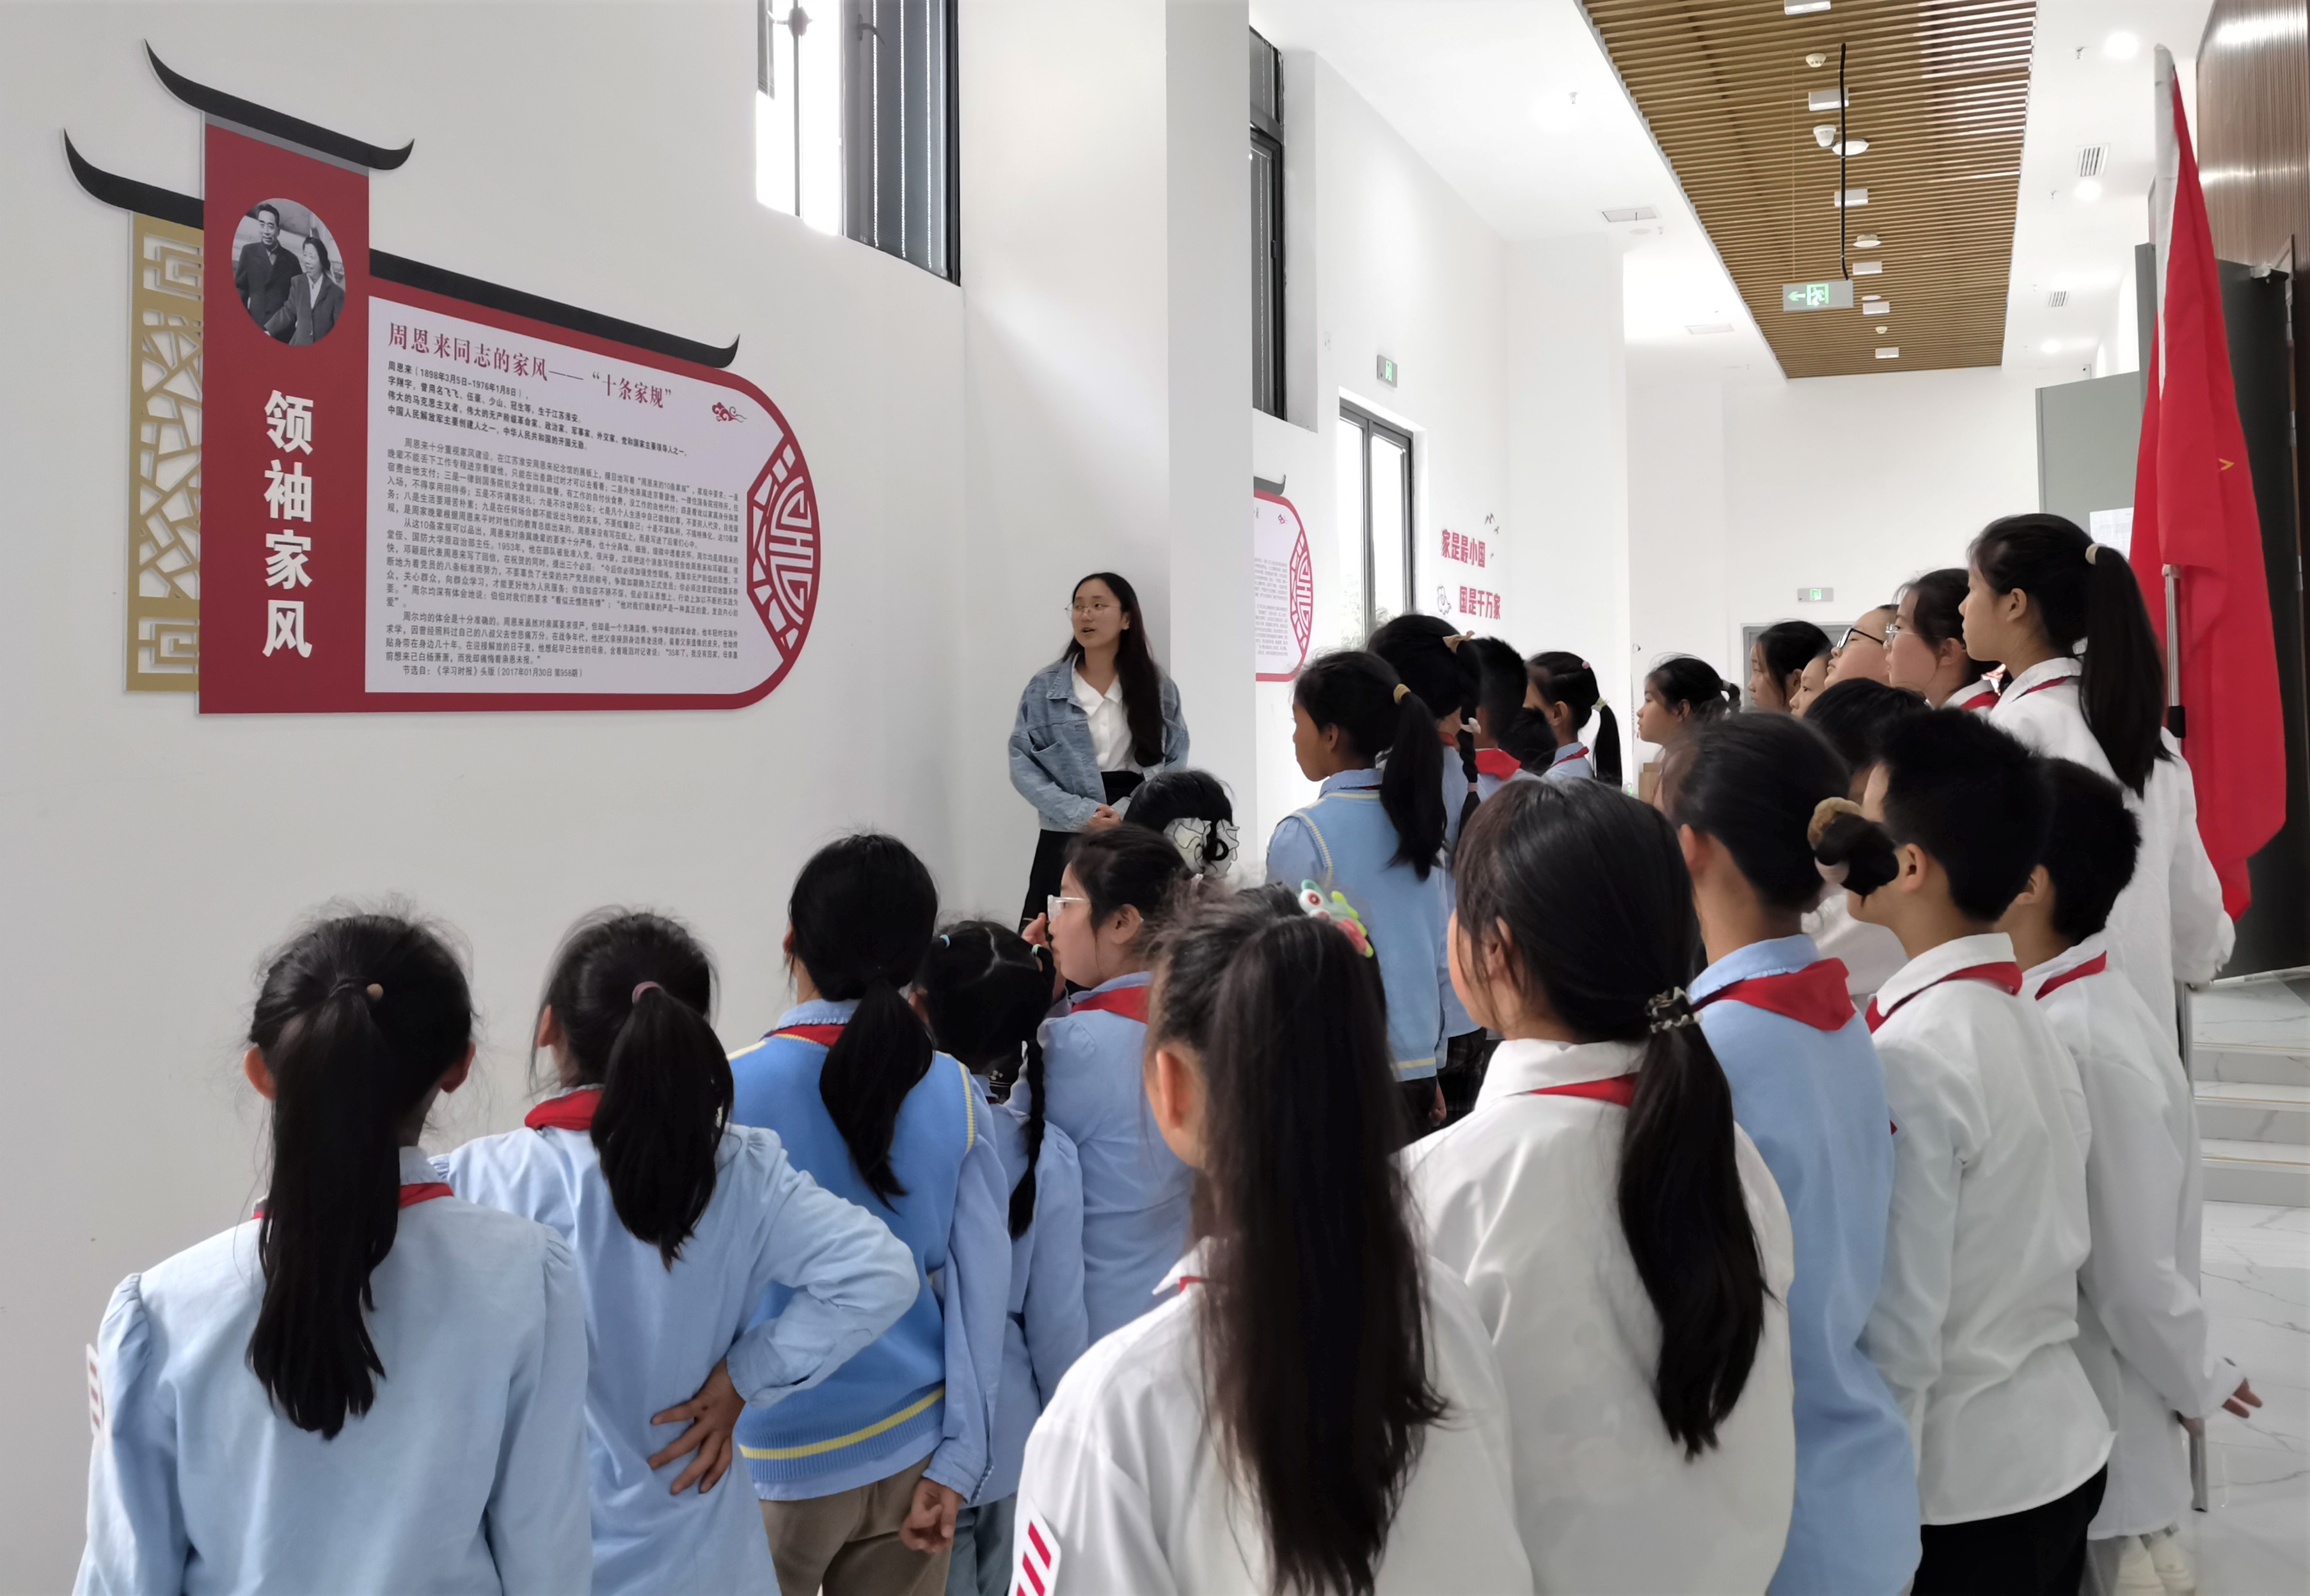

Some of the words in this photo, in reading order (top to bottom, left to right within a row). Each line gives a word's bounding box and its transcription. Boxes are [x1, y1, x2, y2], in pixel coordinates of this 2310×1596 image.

[262, 390, 313, 658] 领袖家风
[1442, 529, 1485, 568] 家是最小国
[1459, 586, 1501, 620] 国是千万家
